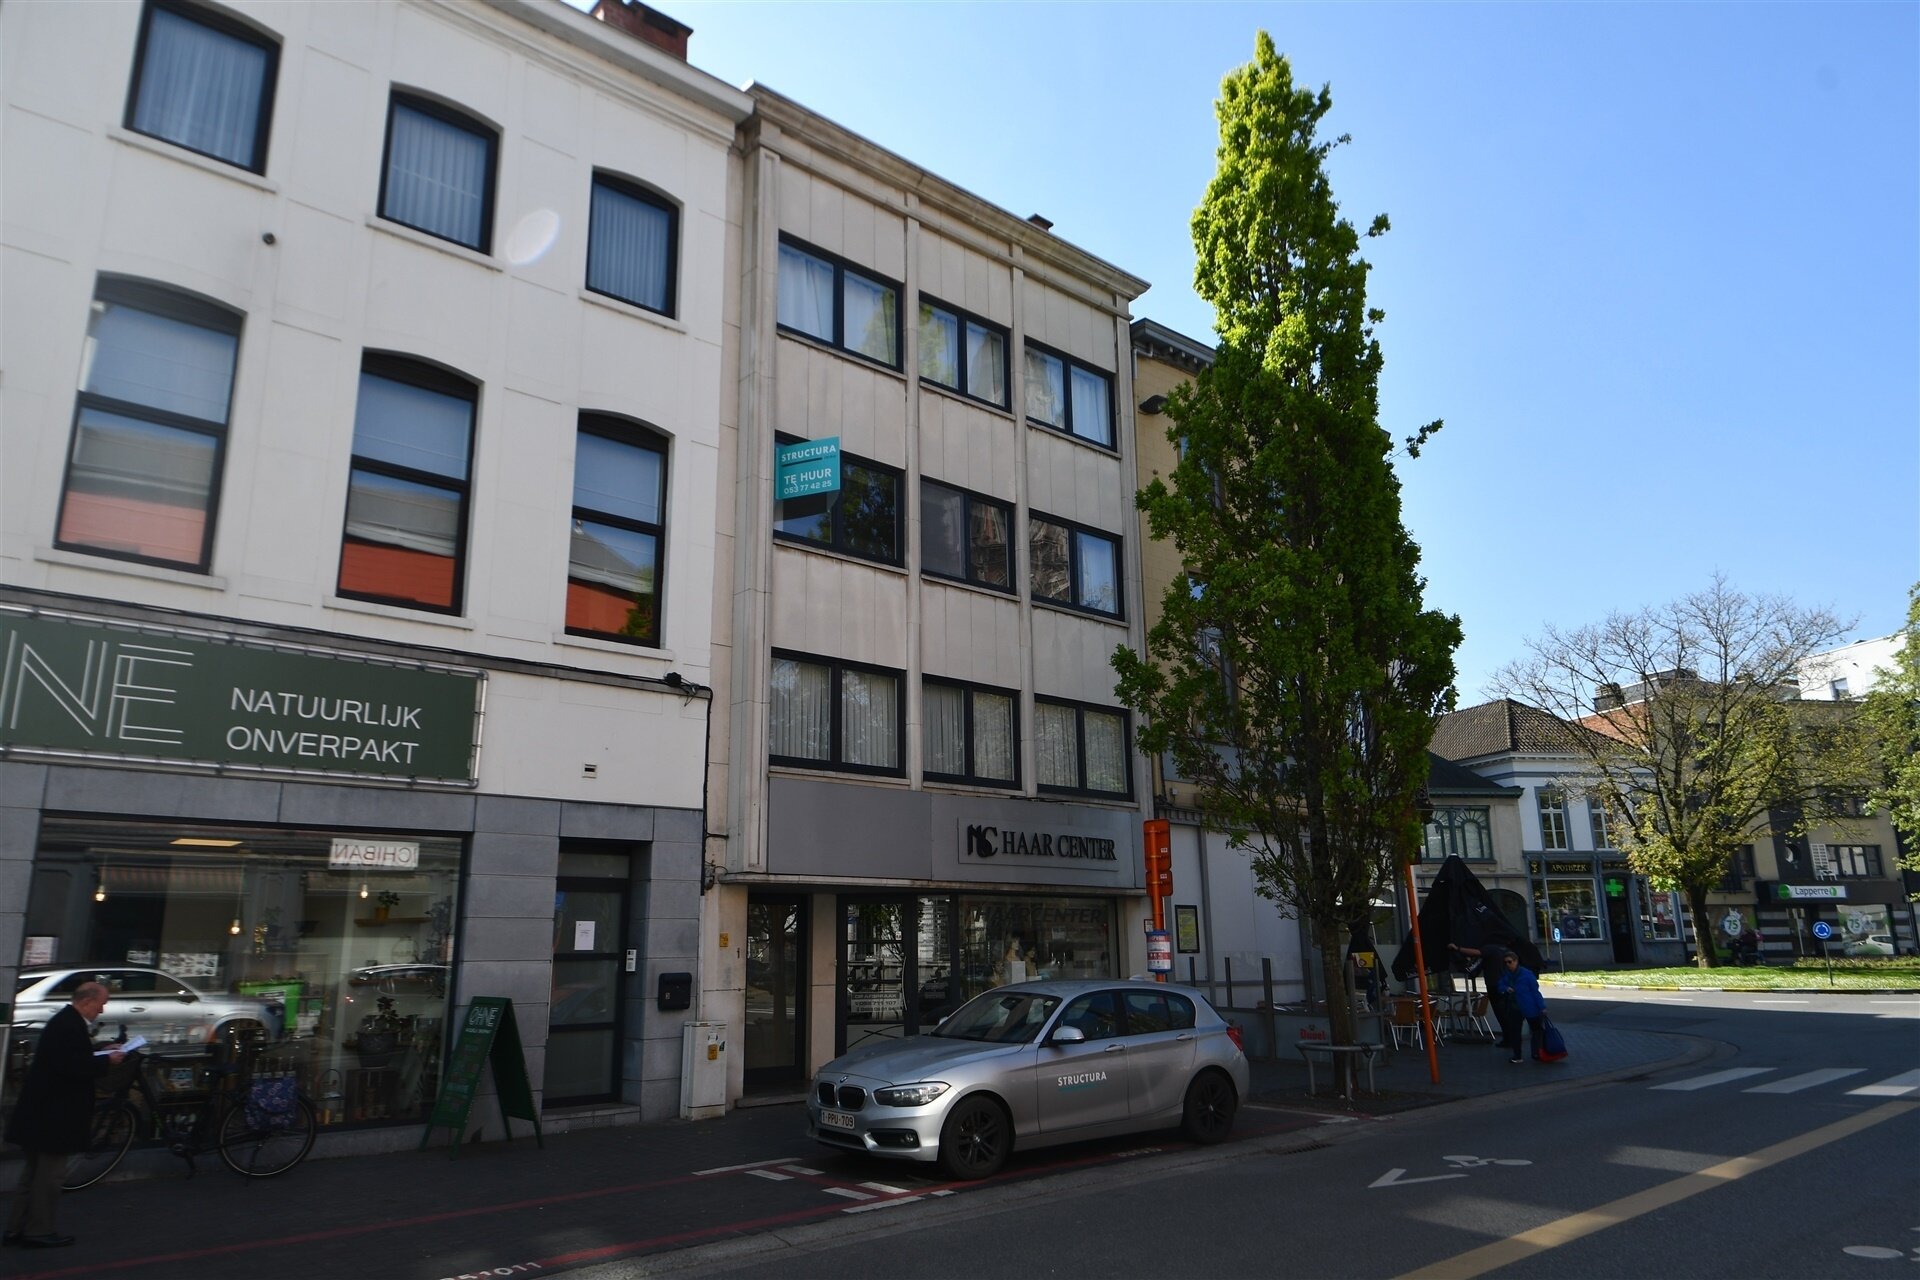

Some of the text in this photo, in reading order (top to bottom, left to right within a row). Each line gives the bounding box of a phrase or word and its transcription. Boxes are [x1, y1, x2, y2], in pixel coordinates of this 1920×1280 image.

[781, 445, 836, 462] STRUCTURA
[784, 468, 832, 485] TE HUUR
[231, 687, 423, 730] NATUURLIJK
[226, 725, 420, 764] ONVERPAKT
[1002, 831, 1054, 857] HAAR
[1057, 835, 1117, 861] CENTER
[1795, 887, 1829, 896] Lapperre
[1057, 1071, 1107, 1087] STRUCTURA
